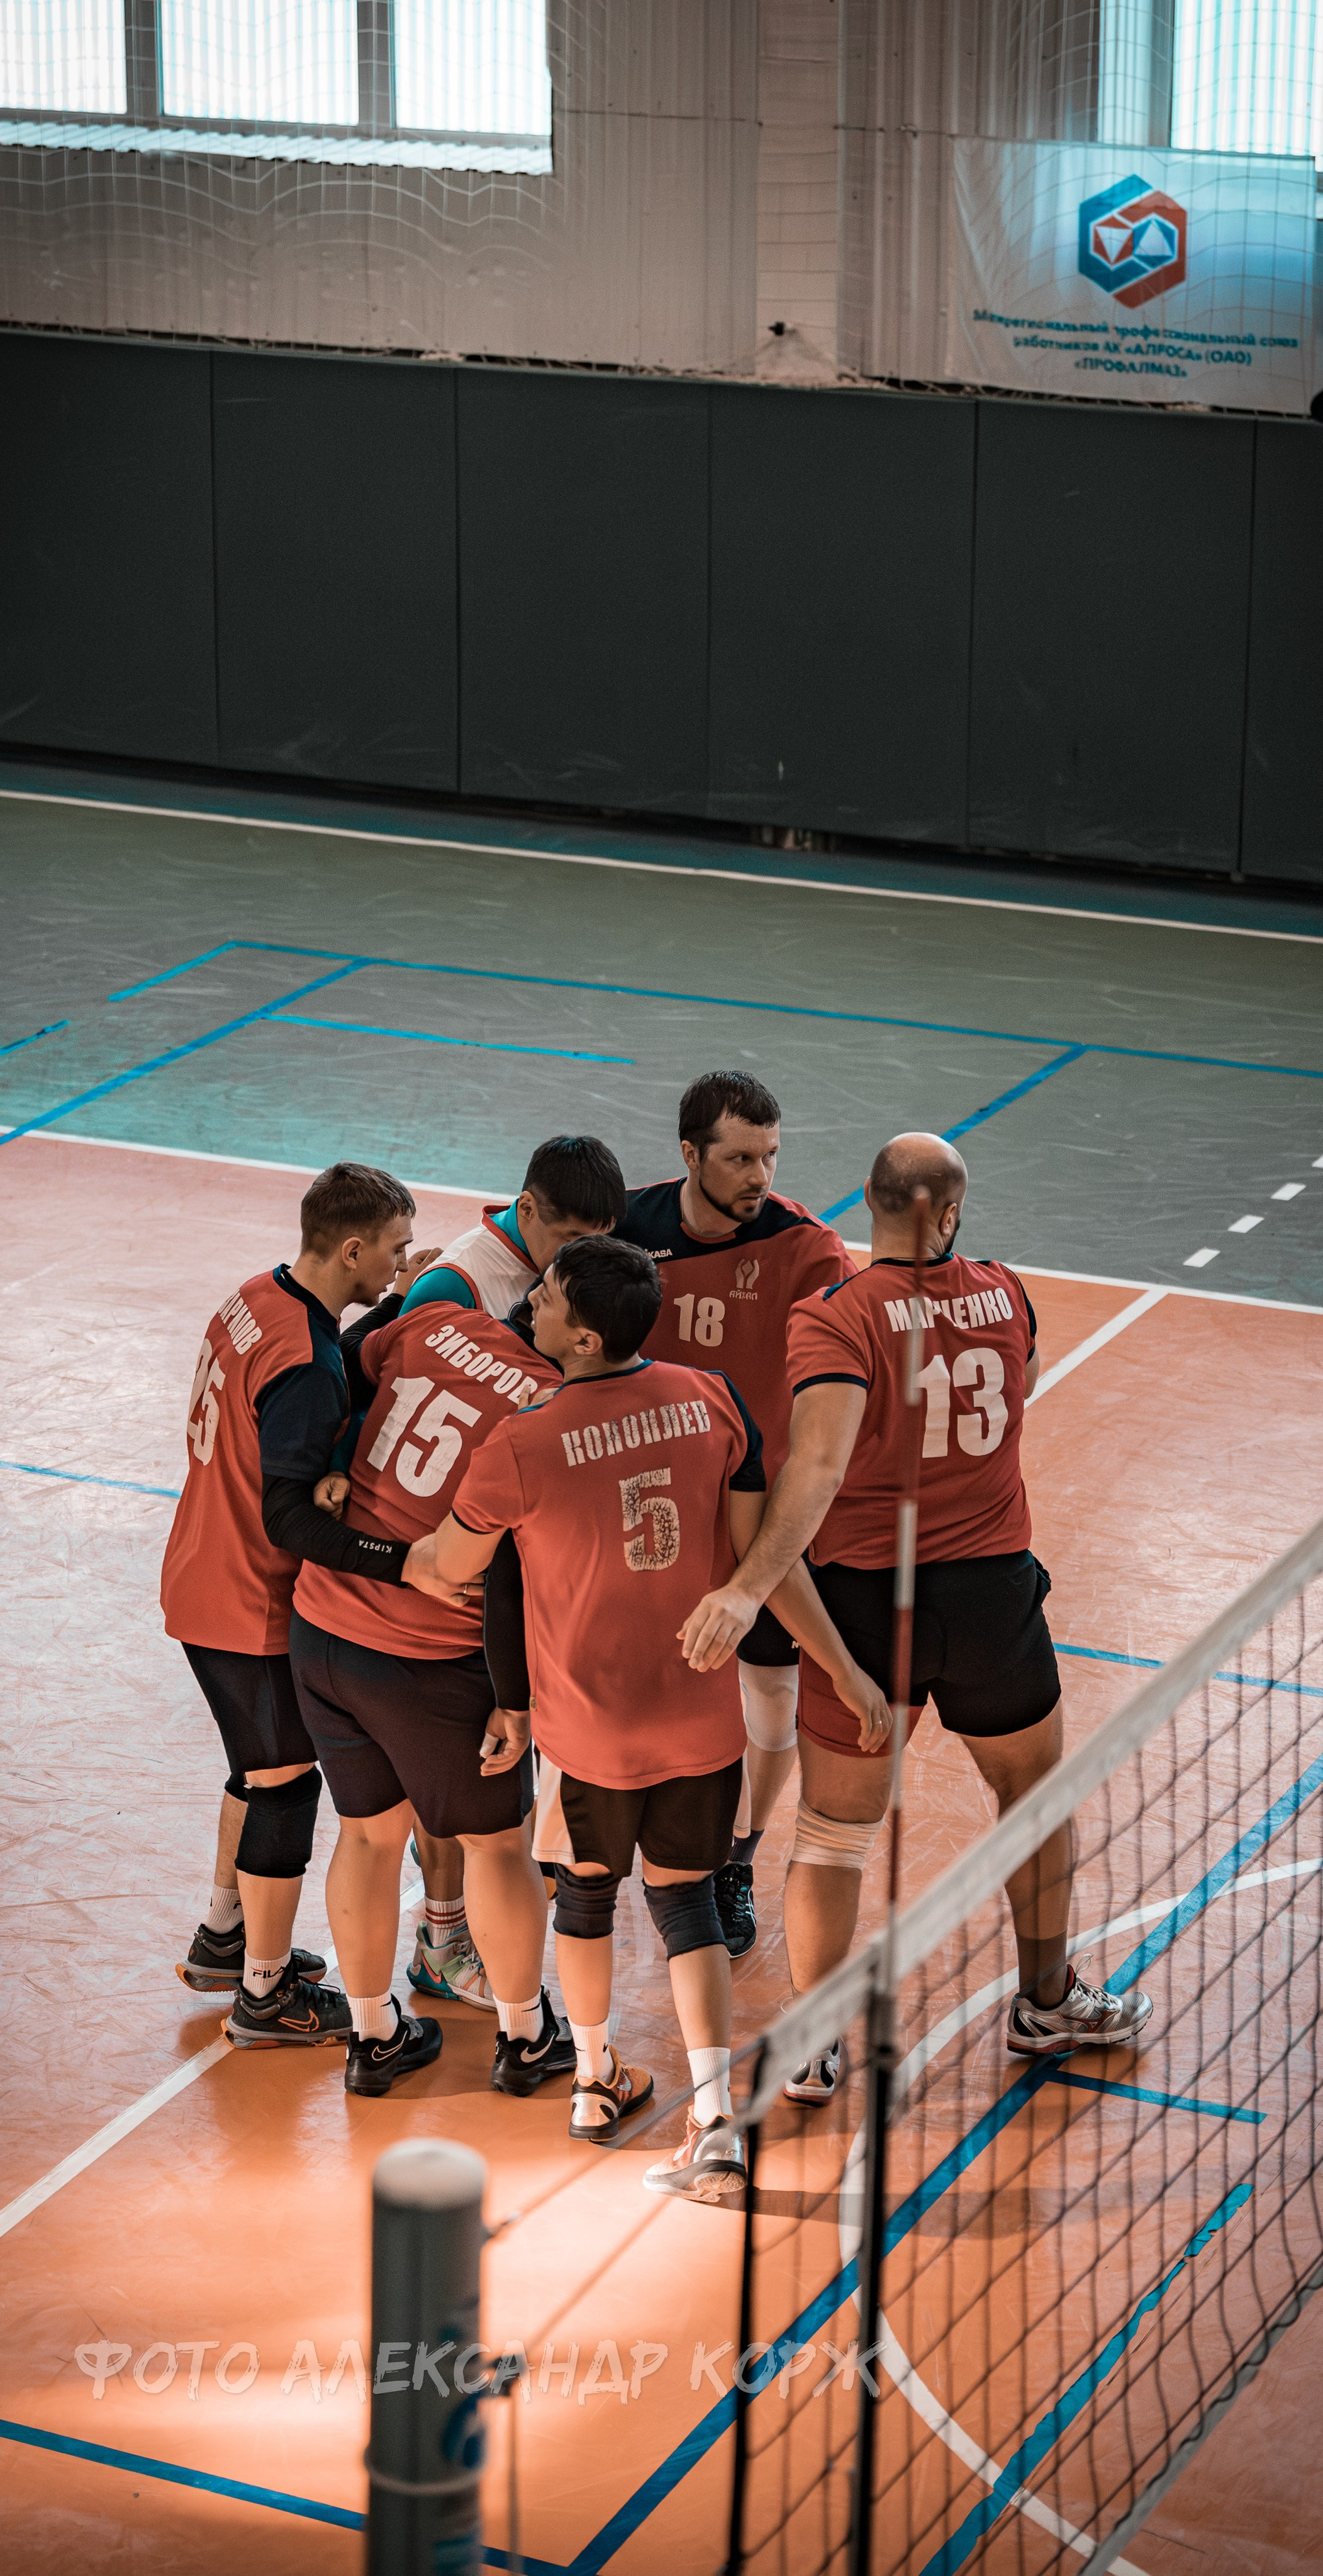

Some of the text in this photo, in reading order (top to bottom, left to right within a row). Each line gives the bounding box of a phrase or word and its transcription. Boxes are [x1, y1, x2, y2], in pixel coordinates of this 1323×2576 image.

[1205, 349, 1252, 366] (ОАО)
[674, 1293, 725, 1347] 18
[187, 1338, 226, 1466] 25
[366, 1375, 483, 1498] 15
[913, 1347, 1008, 1458] 13
[359, 1540, 393, 1553] KIPSTA
[618, 1467, 680, 1572] 5
